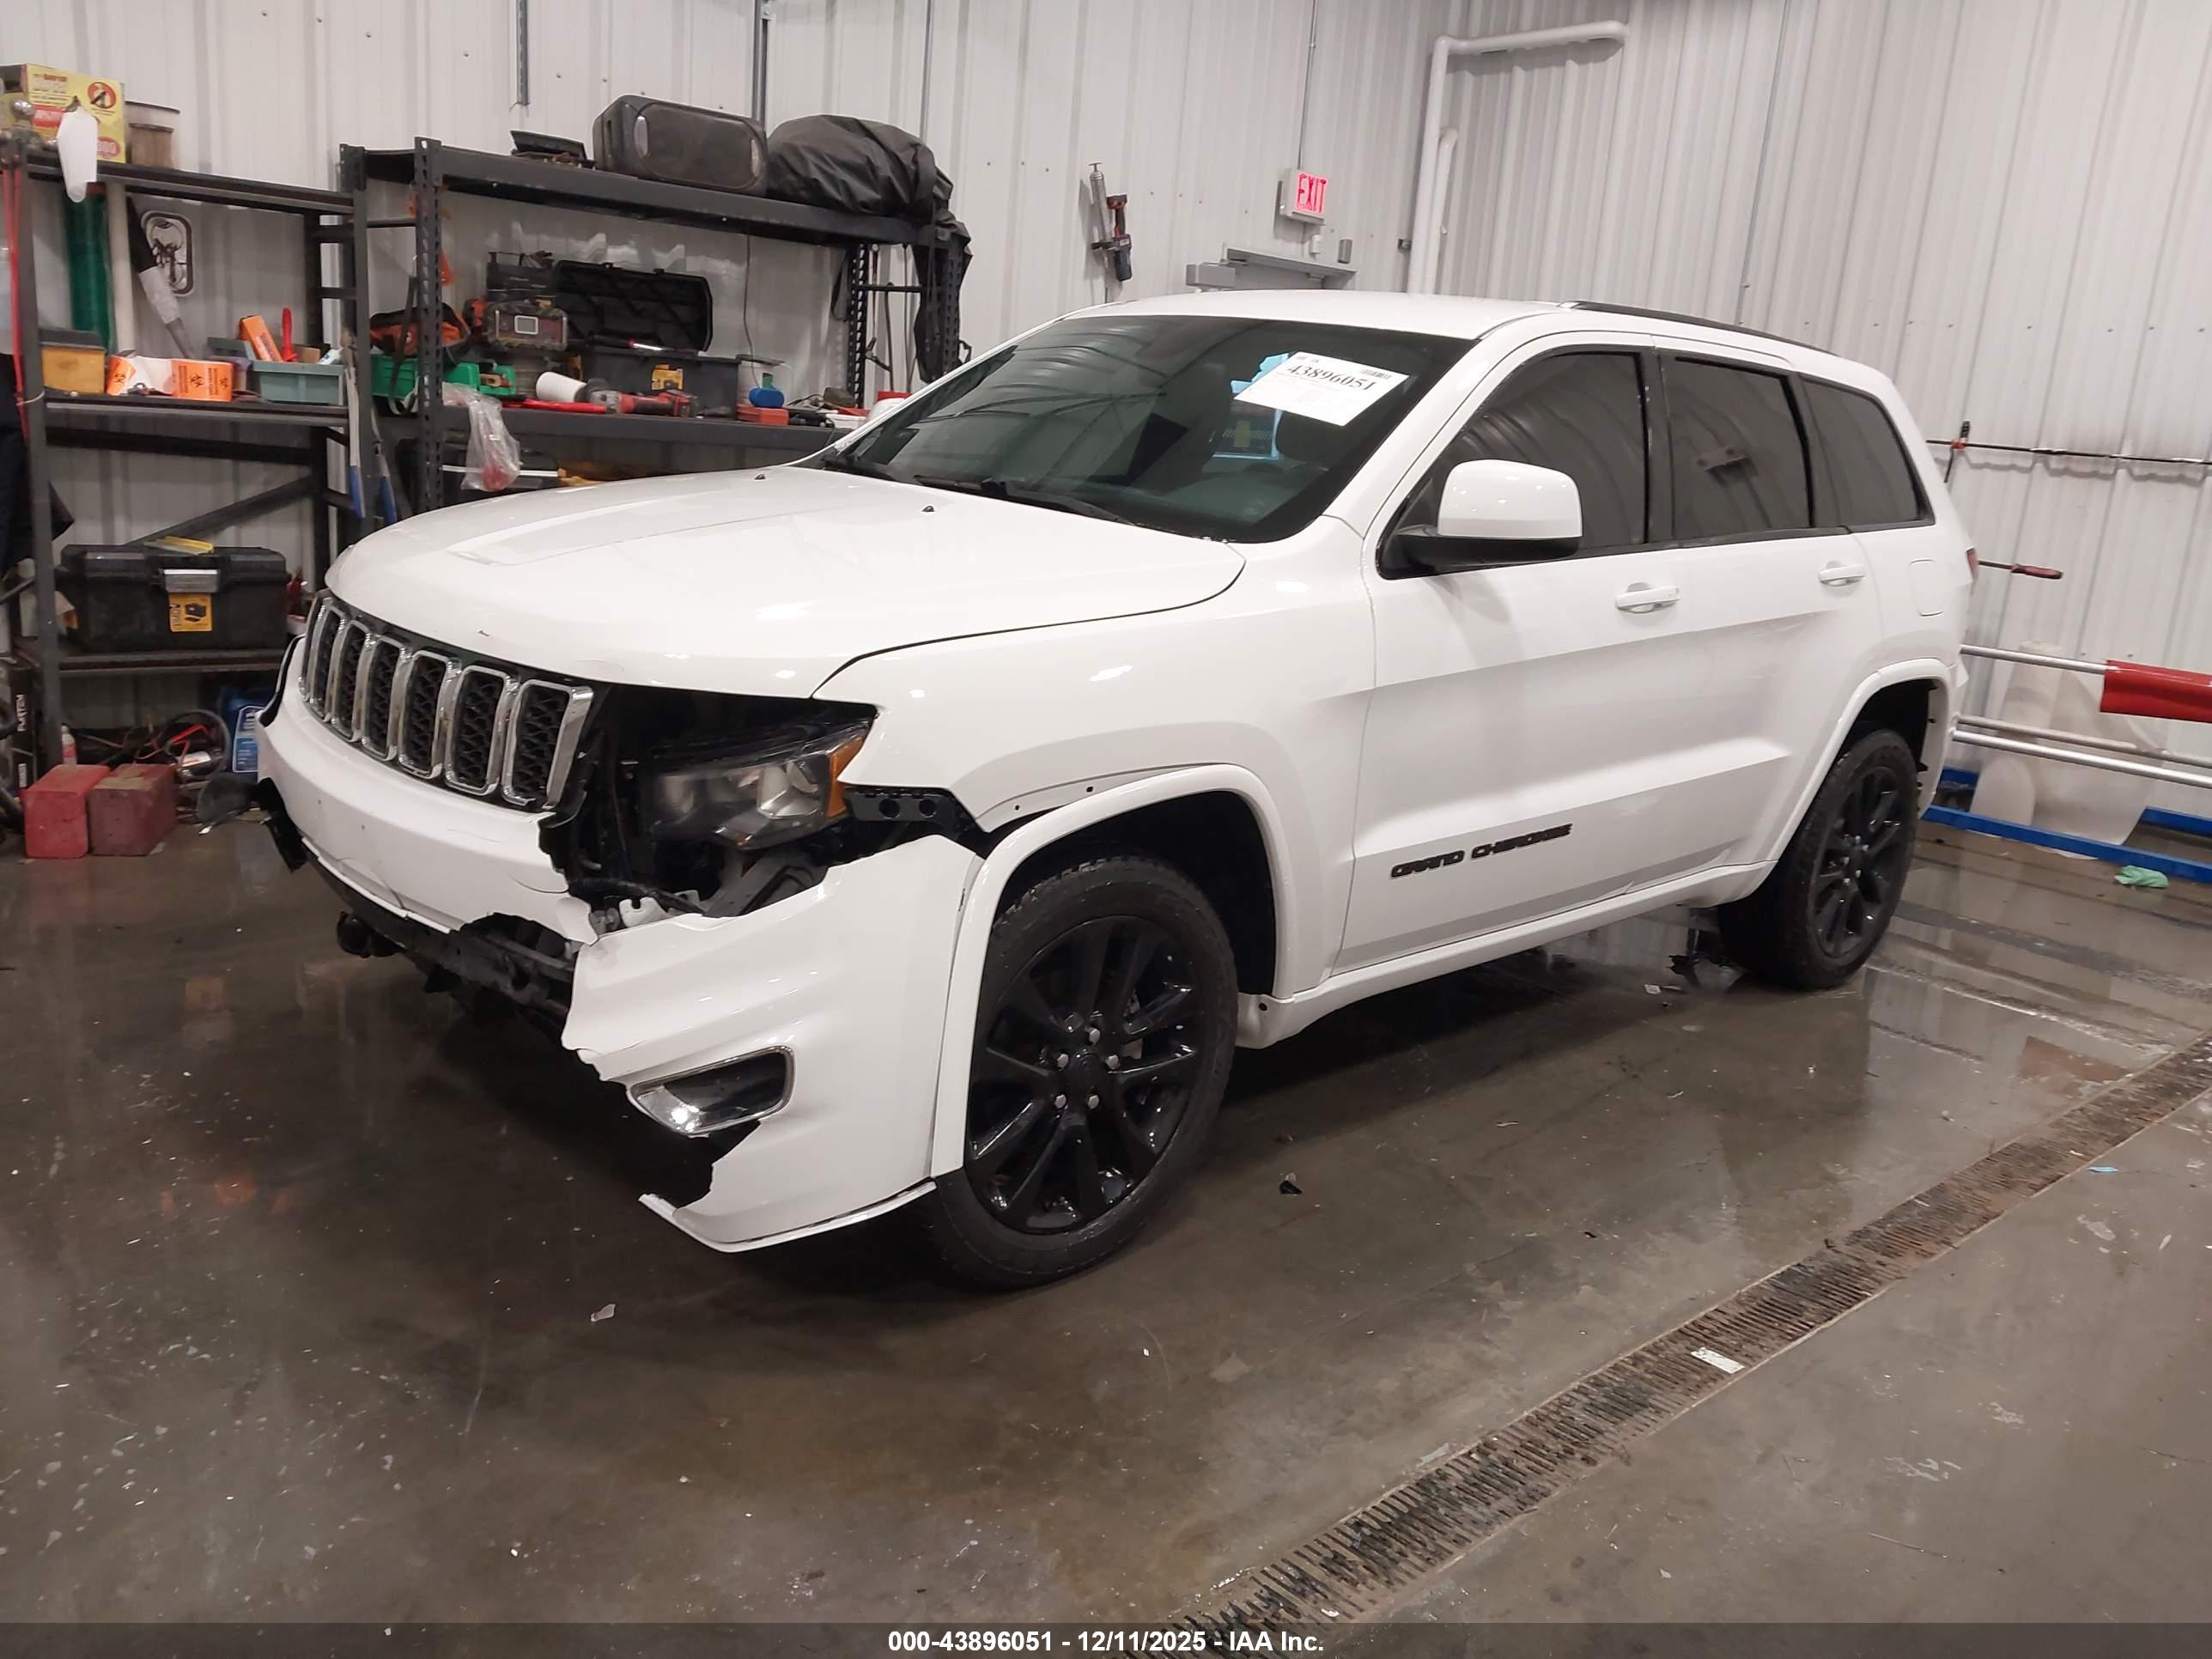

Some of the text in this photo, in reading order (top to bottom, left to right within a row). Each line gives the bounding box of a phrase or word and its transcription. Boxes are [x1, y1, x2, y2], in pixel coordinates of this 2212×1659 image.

[1297, 173, 1327, 213] EXIT
[1288, 364, 1376, 391] 43896051
[1391, 823, 1573, 878] GRAND CHEROKEE
